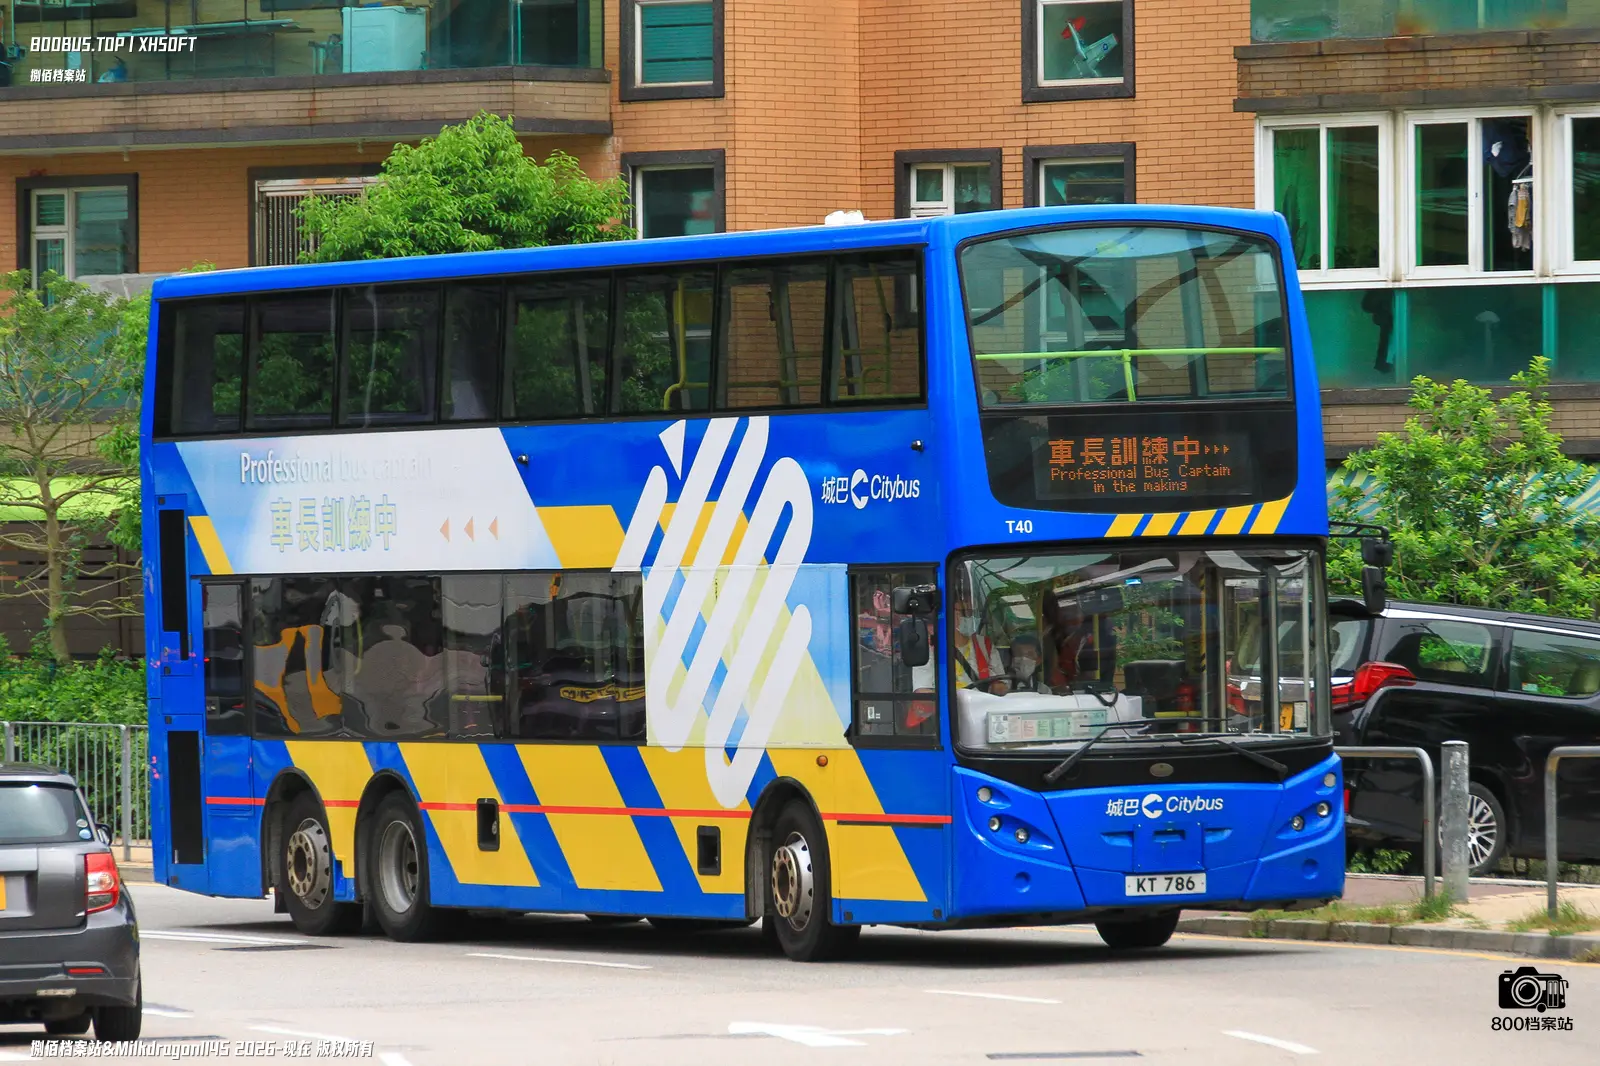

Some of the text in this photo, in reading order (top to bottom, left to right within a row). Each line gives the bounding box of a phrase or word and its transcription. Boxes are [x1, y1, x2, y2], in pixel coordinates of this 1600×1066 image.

[1048, 435, 1200, 468] 車長訓練中
[240, 448, 334, 484] Professional
[1051, 463, 1231, 481] Professional Bus Captain
[821, 474, 920, 504] 城巴 Citybus
[1093, 479, 1188, 493] in the making
[269, 494, 397, 553] 車長訓練中
[1005, 519, 1033, 534] T40
[1105, 795, 1224, 816] 城巴 Citybus
[1136, 876, 1196, 893] KT 786
